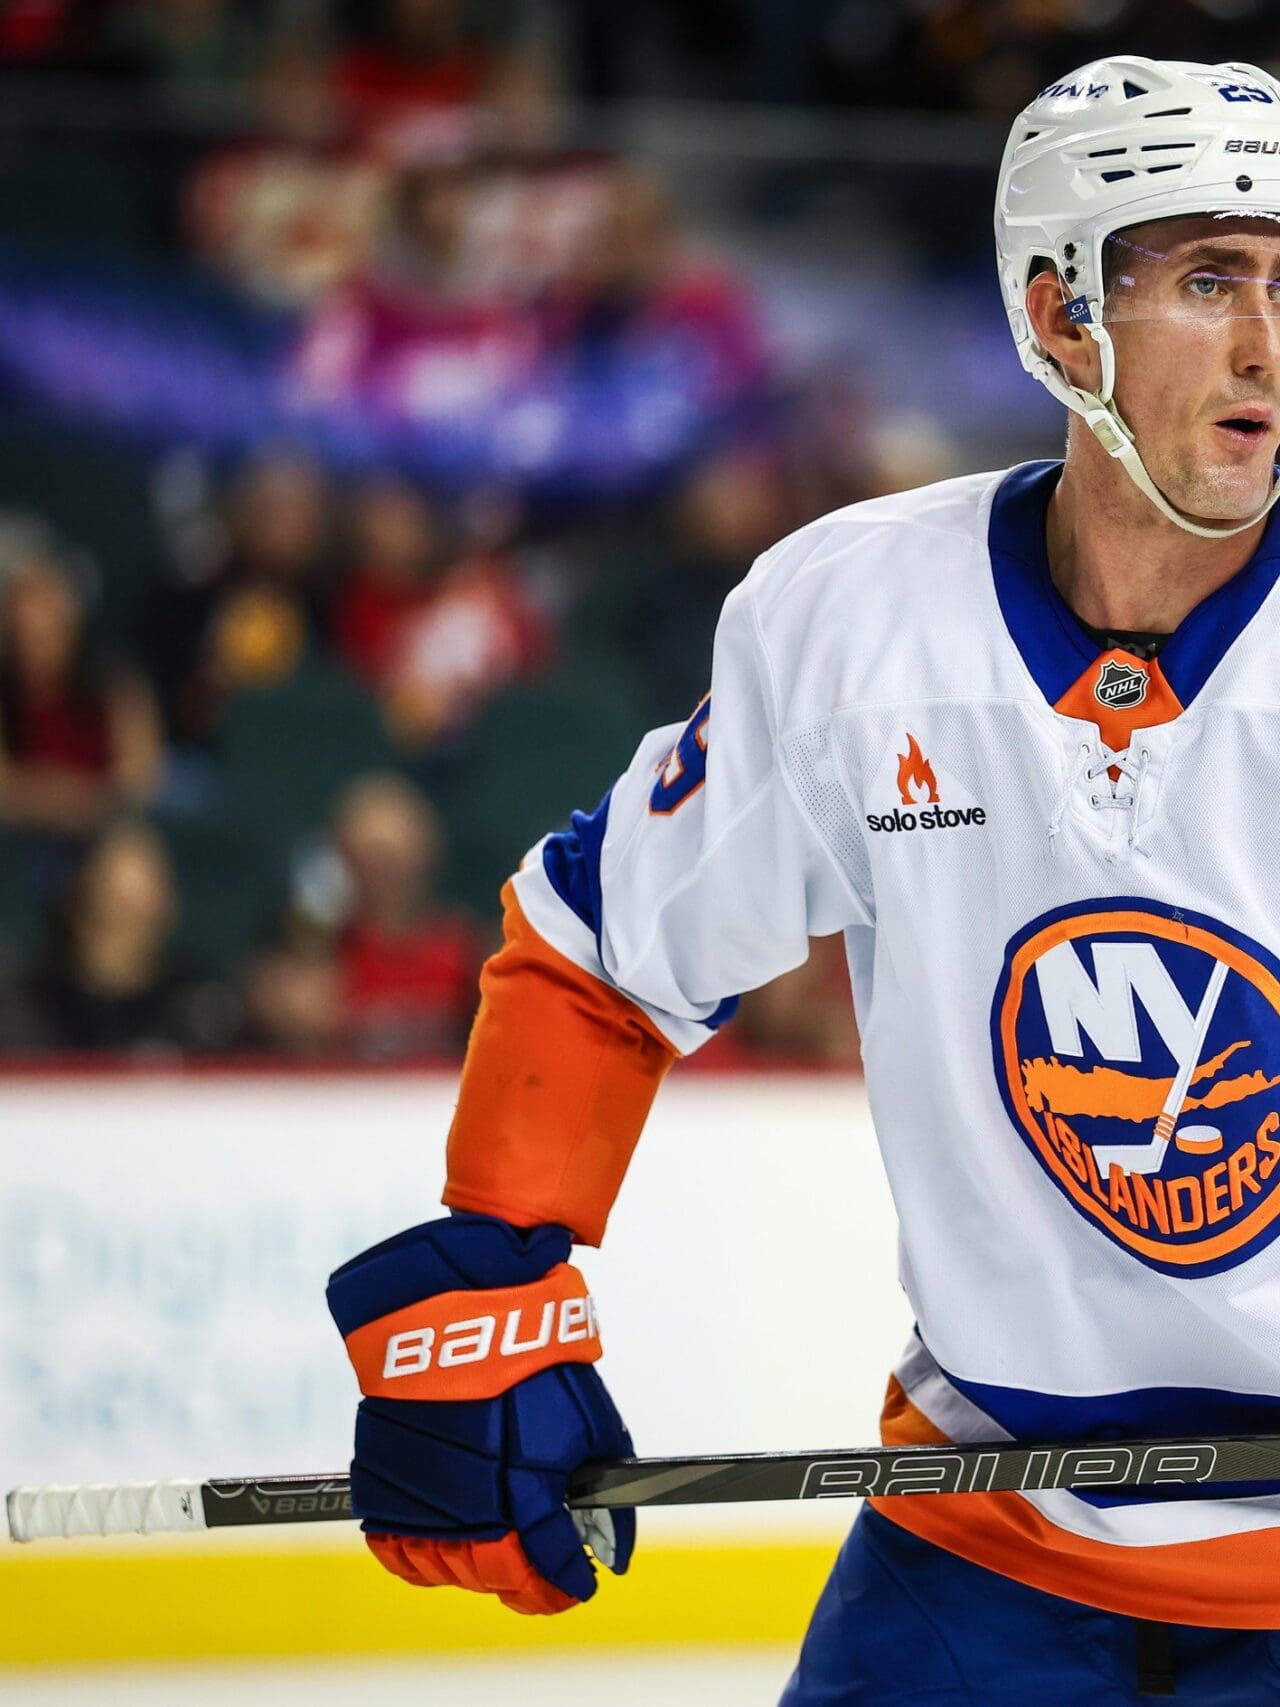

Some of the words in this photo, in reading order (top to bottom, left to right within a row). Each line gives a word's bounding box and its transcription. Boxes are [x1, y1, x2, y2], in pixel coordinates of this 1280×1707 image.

[1104, 679, 1139, 699] NHL
[866, 807, 917, 833] solo
[920, 804, 986, 831] stove
[1034, 940, 1228, 1085] NY
